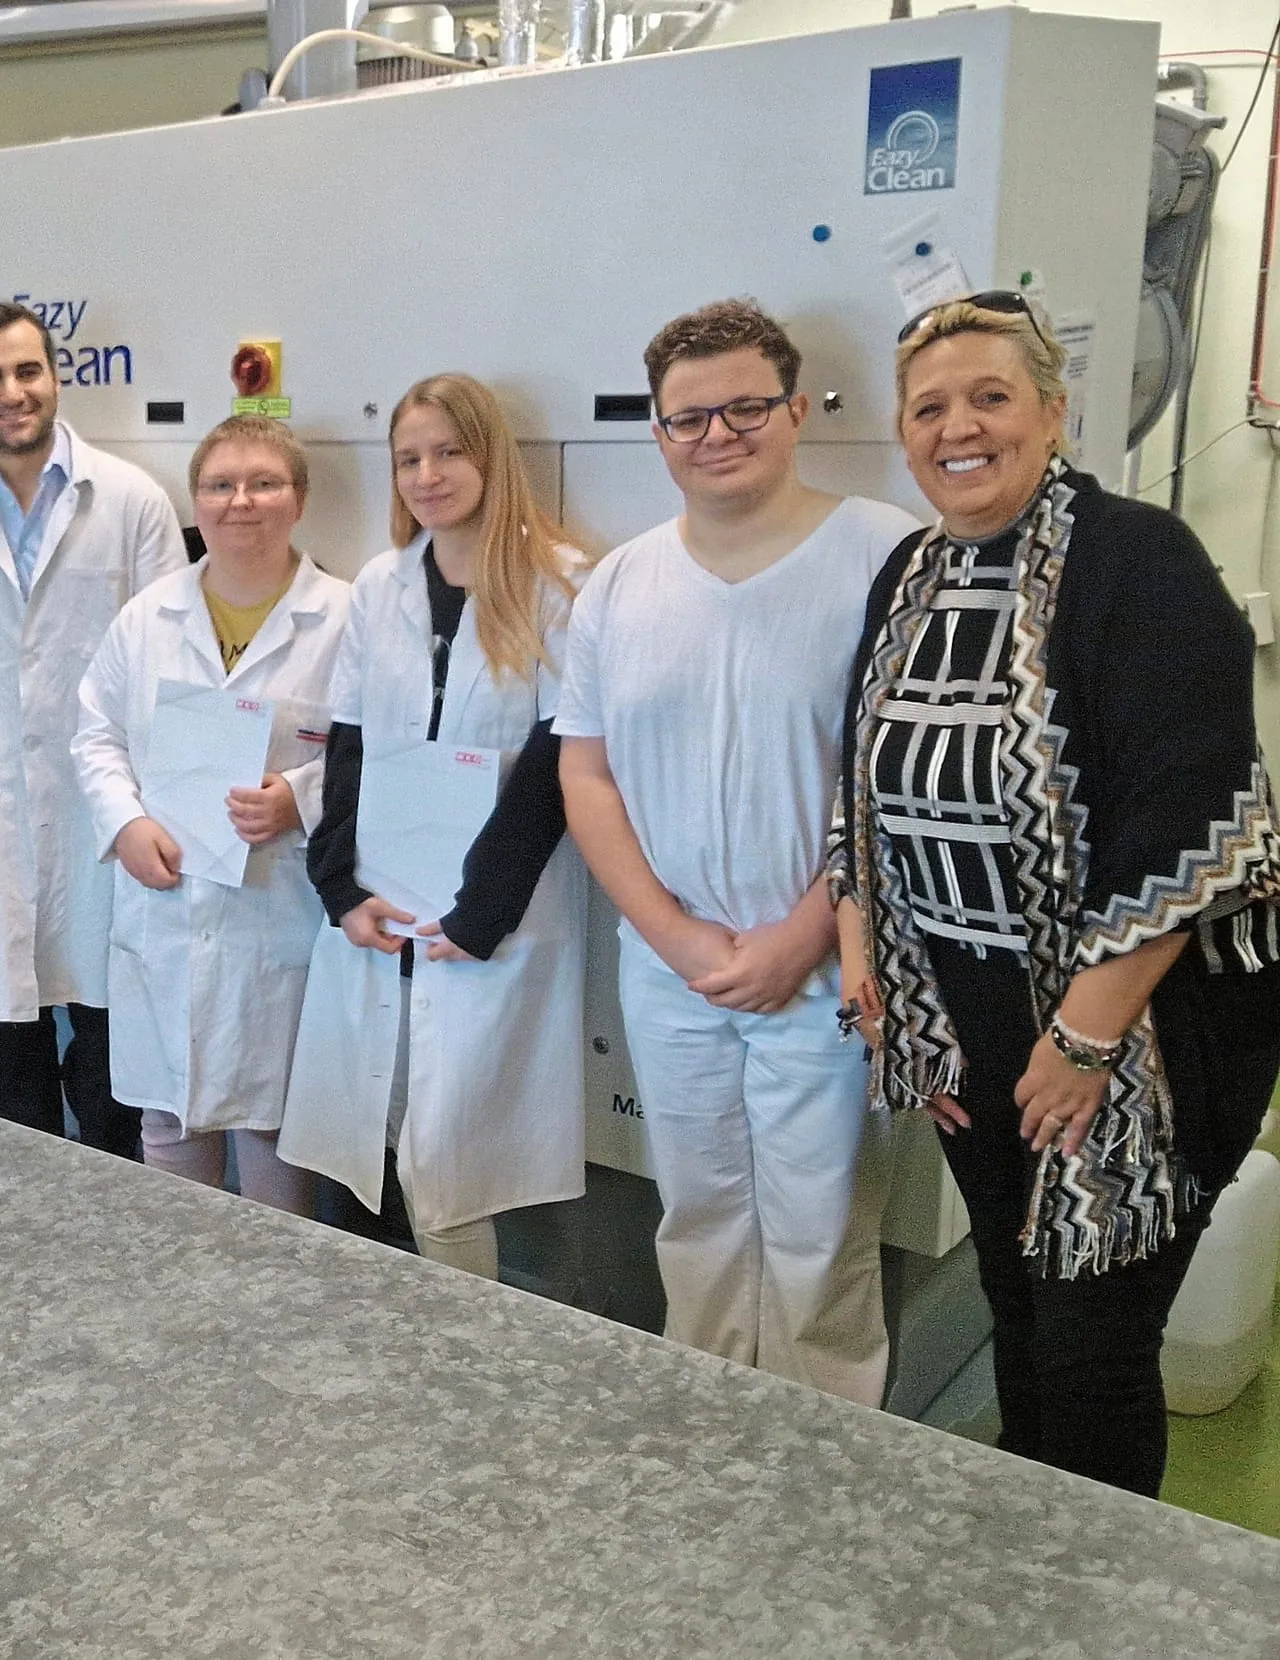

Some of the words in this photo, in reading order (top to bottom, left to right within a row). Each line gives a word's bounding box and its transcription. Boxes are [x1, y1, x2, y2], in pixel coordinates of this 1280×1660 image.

[871, 147, 920, 170] Eazy
[868, 166, 945, 191] Clean
[13, 293, 87, 341] azy
[56, 344, 133, 386] ean
